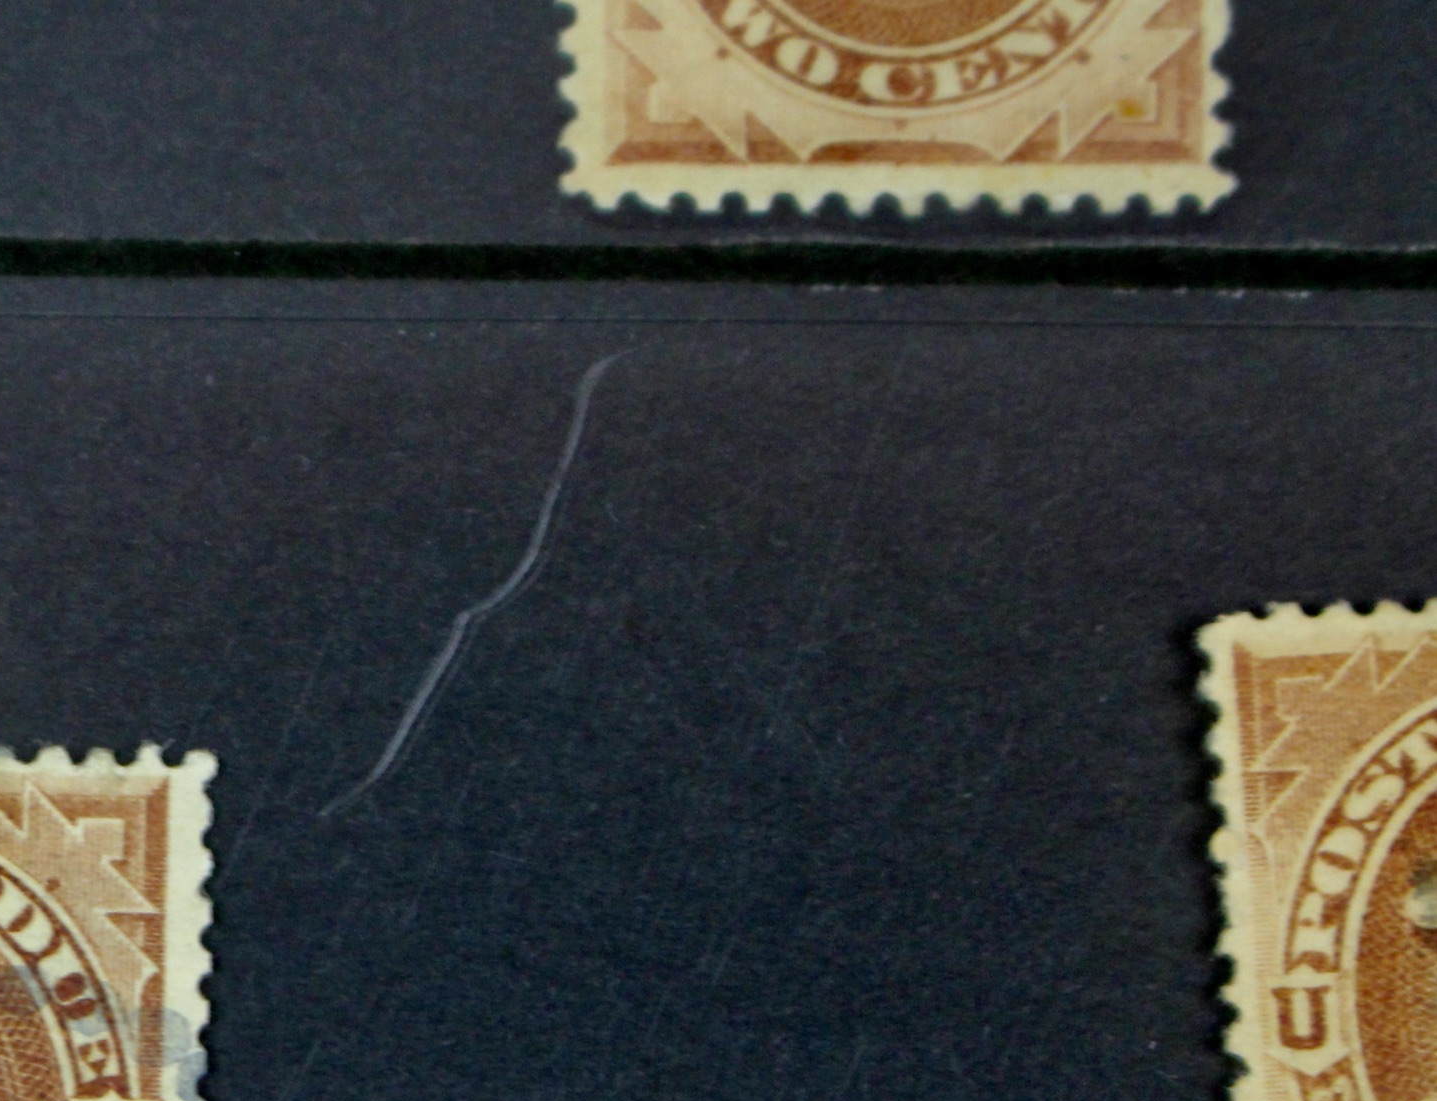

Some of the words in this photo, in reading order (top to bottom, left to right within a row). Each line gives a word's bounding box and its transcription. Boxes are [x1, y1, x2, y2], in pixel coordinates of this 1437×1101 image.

[722, 0, 838, 86] WO
[859, 0, 1100, 100] CEN
[1290, 718, 1437, 958] POST
[1271, 985, 1332, 1051] U
